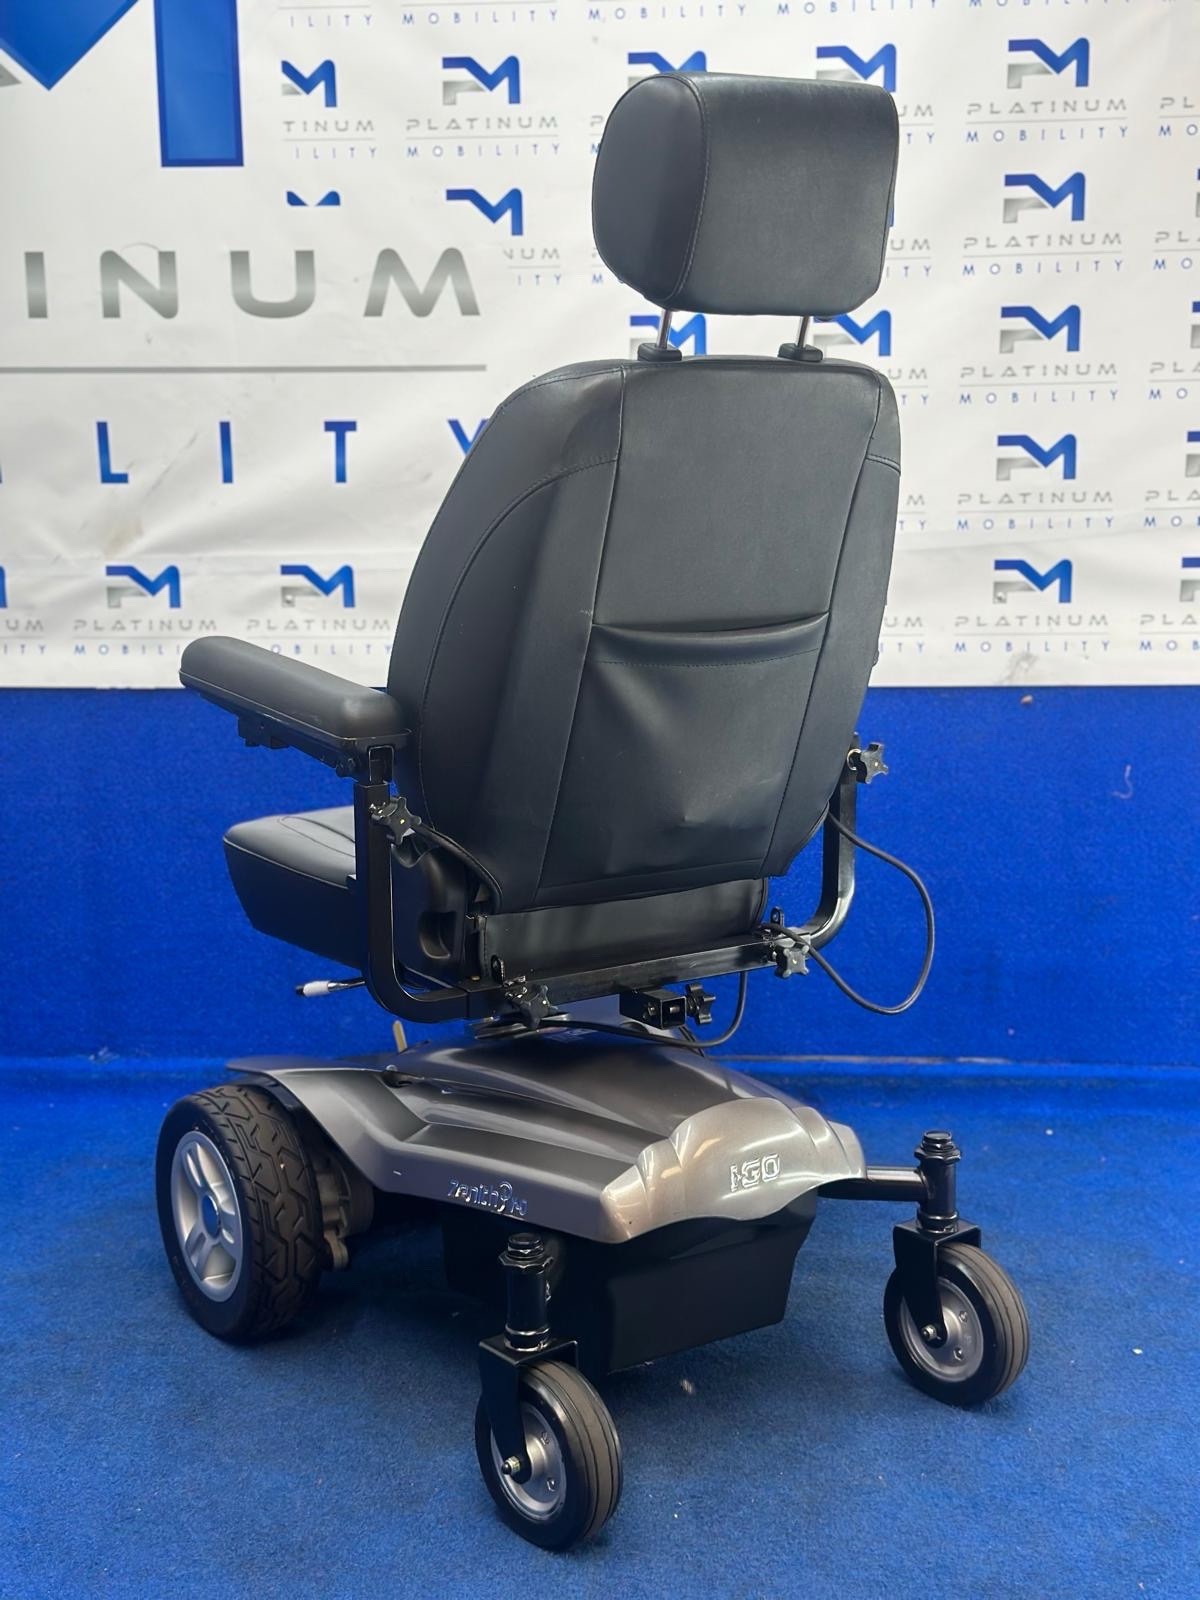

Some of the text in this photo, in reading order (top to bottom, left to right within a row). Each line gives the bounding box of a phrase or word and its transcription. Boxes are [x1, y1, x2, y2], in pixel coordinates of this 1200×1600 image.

[402, 10, 558, 24] MOBILITY
[588, 4, 747, 20] MOBILITY
[966, 98, 1127, 116] PLATINUM
[406, 115, 558, 130] PLATINUM
[966, 126, 1128, 142] MOBILITY
[407, 143, 559, 157] MOBILITY
[963, 233, 1122, 249] PLATINUM
[963, 260, 1124, 276] MOBILITY
[960, 363, 1117, 378] PLATINUM
[960, 390, 1118, 404] MOBILITY
[957, 491, 1113, 505] PLATINUM
[957, 517, 1114, 530] MOBILITY
[73, 620, 217, 631] PLATINUM
[247, 619, 391, 631] PLATINUM
[954, 615, 1109, 627] PLATINUM
[954, 641, 1110, 653] MOBILITY
